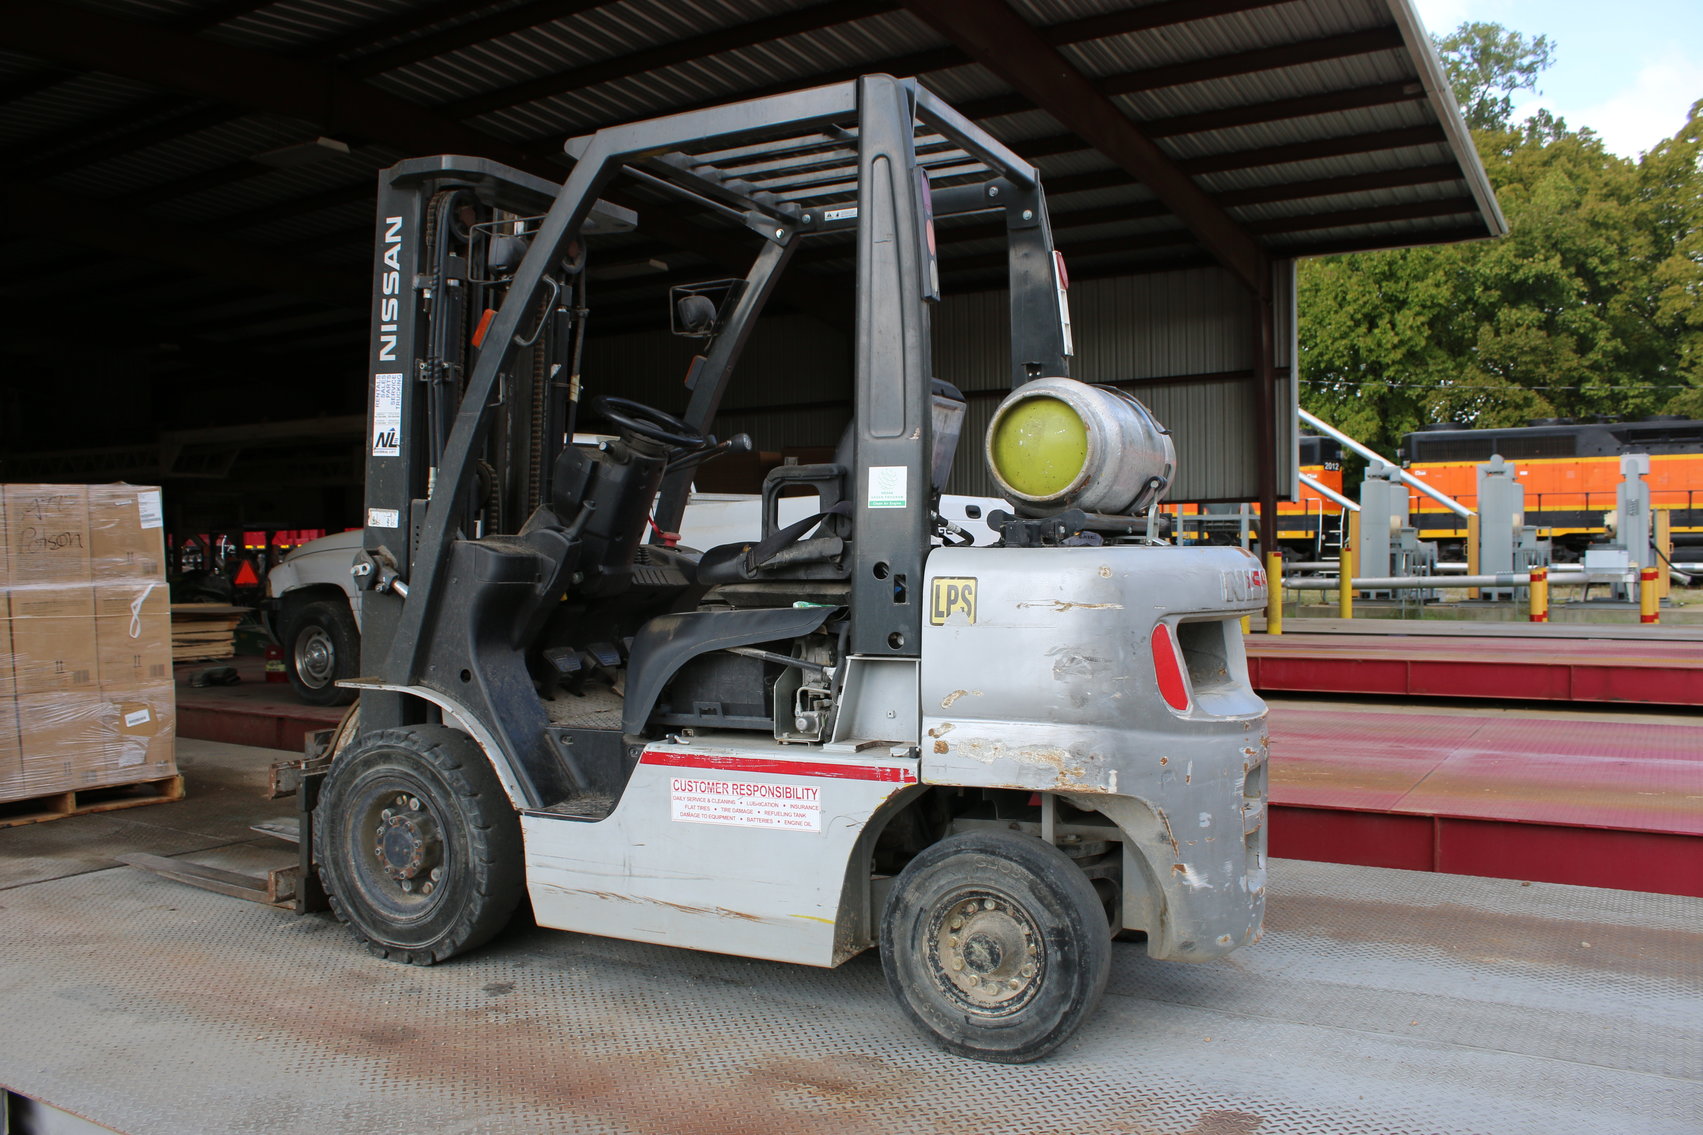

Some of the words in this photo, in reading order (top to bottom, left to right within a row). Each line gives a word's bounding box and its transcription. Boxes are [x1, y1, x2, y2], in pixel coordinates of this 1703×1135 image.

[379, 216, 403, 361] NISSAN
[375, 432, 398, 448] NL
[1324, 462, 1340, 471] 2012
[934, 584, 973, 618] LPS
[673, 779, 729, 794] CUSTOMER
[732, 783, 818, 800] RESPONSIBILITY
[746, 800, 779, 808] LUBRICATION
[708, 813, 736, 821] EQUIPMENT
